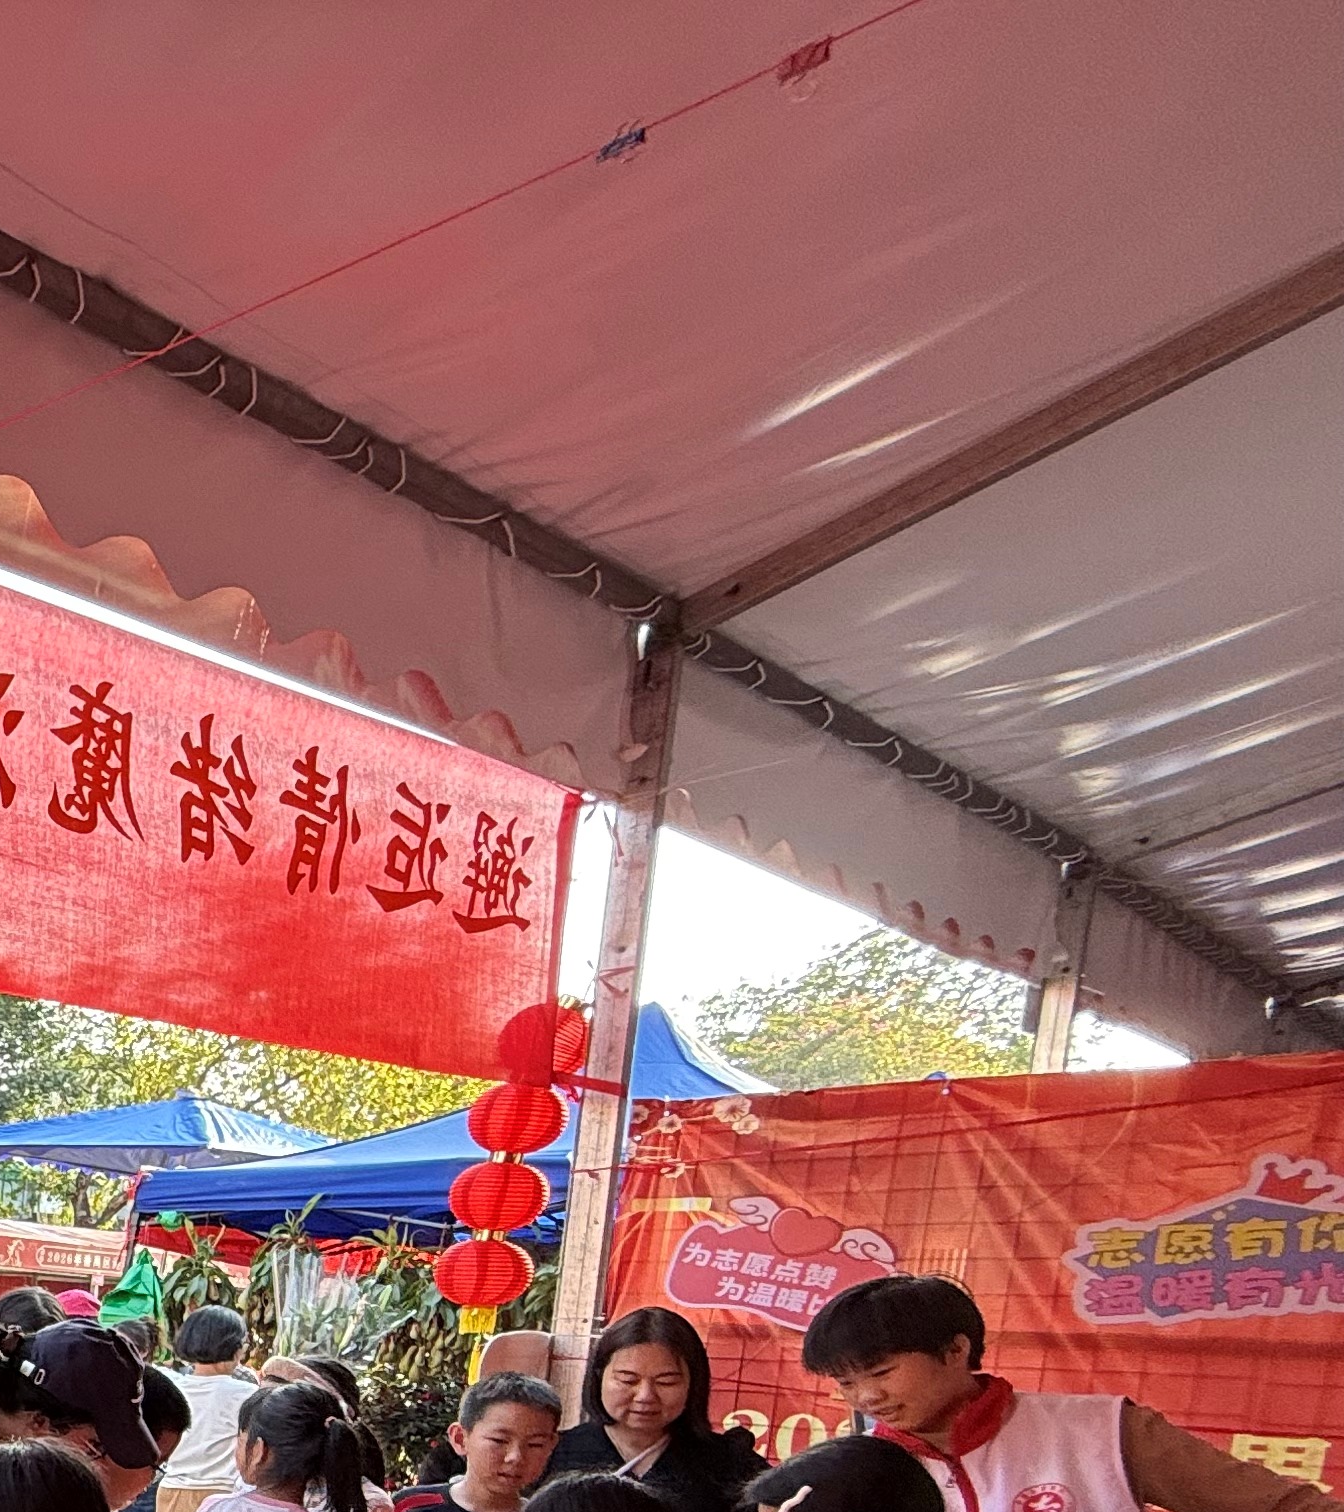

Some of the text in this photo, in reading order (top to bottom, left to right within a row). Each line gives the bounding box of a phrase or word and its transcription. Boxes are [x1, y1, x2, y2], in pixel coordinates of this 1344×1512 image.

[681, 1242, 838, 1291] 为志愿点赞
